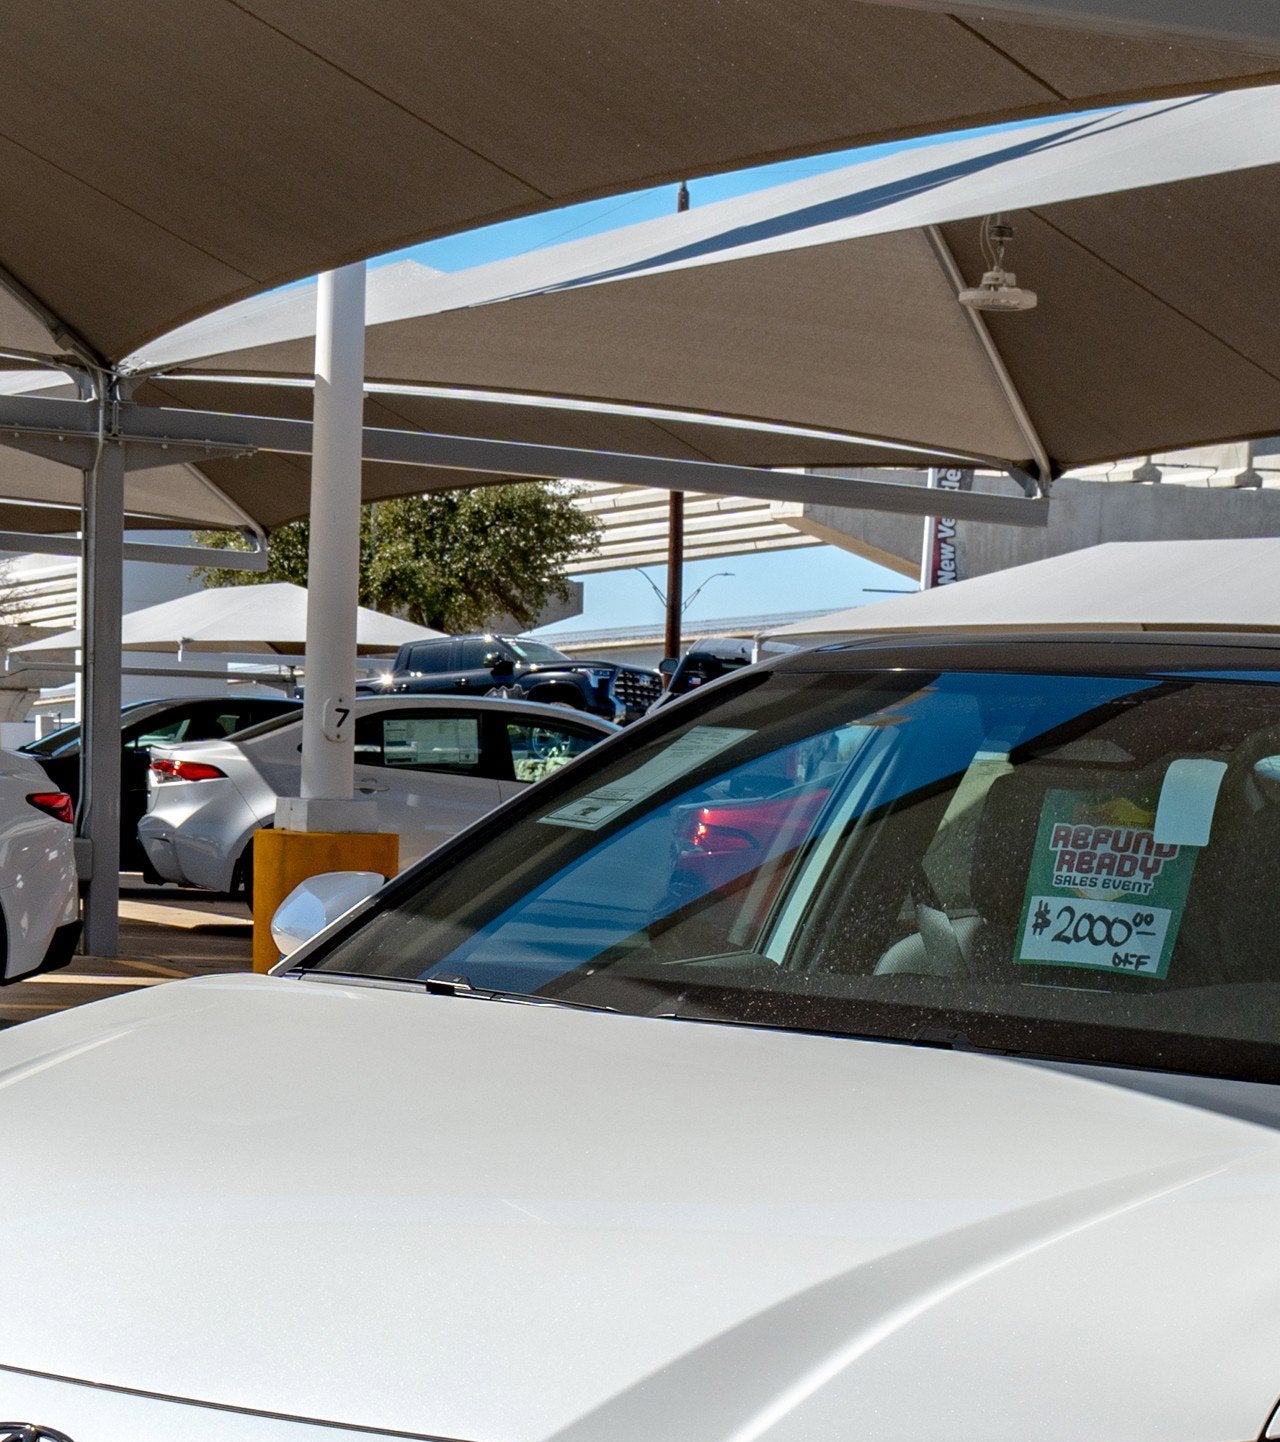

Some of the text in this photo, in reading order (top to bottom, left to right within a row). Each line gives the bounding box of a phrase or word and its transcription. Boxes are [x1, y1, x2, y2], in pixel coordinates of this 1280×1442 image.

[937, 543, 957, 584] New
[335, 708, 350, 728] 7
[1051, 825, 1178, 858] REFUND
[1055, 850, 1162, 880] READY
[1054, 875, 1153, 893] SALES EVENT
[1112, 952, 1152, 969] OFF
